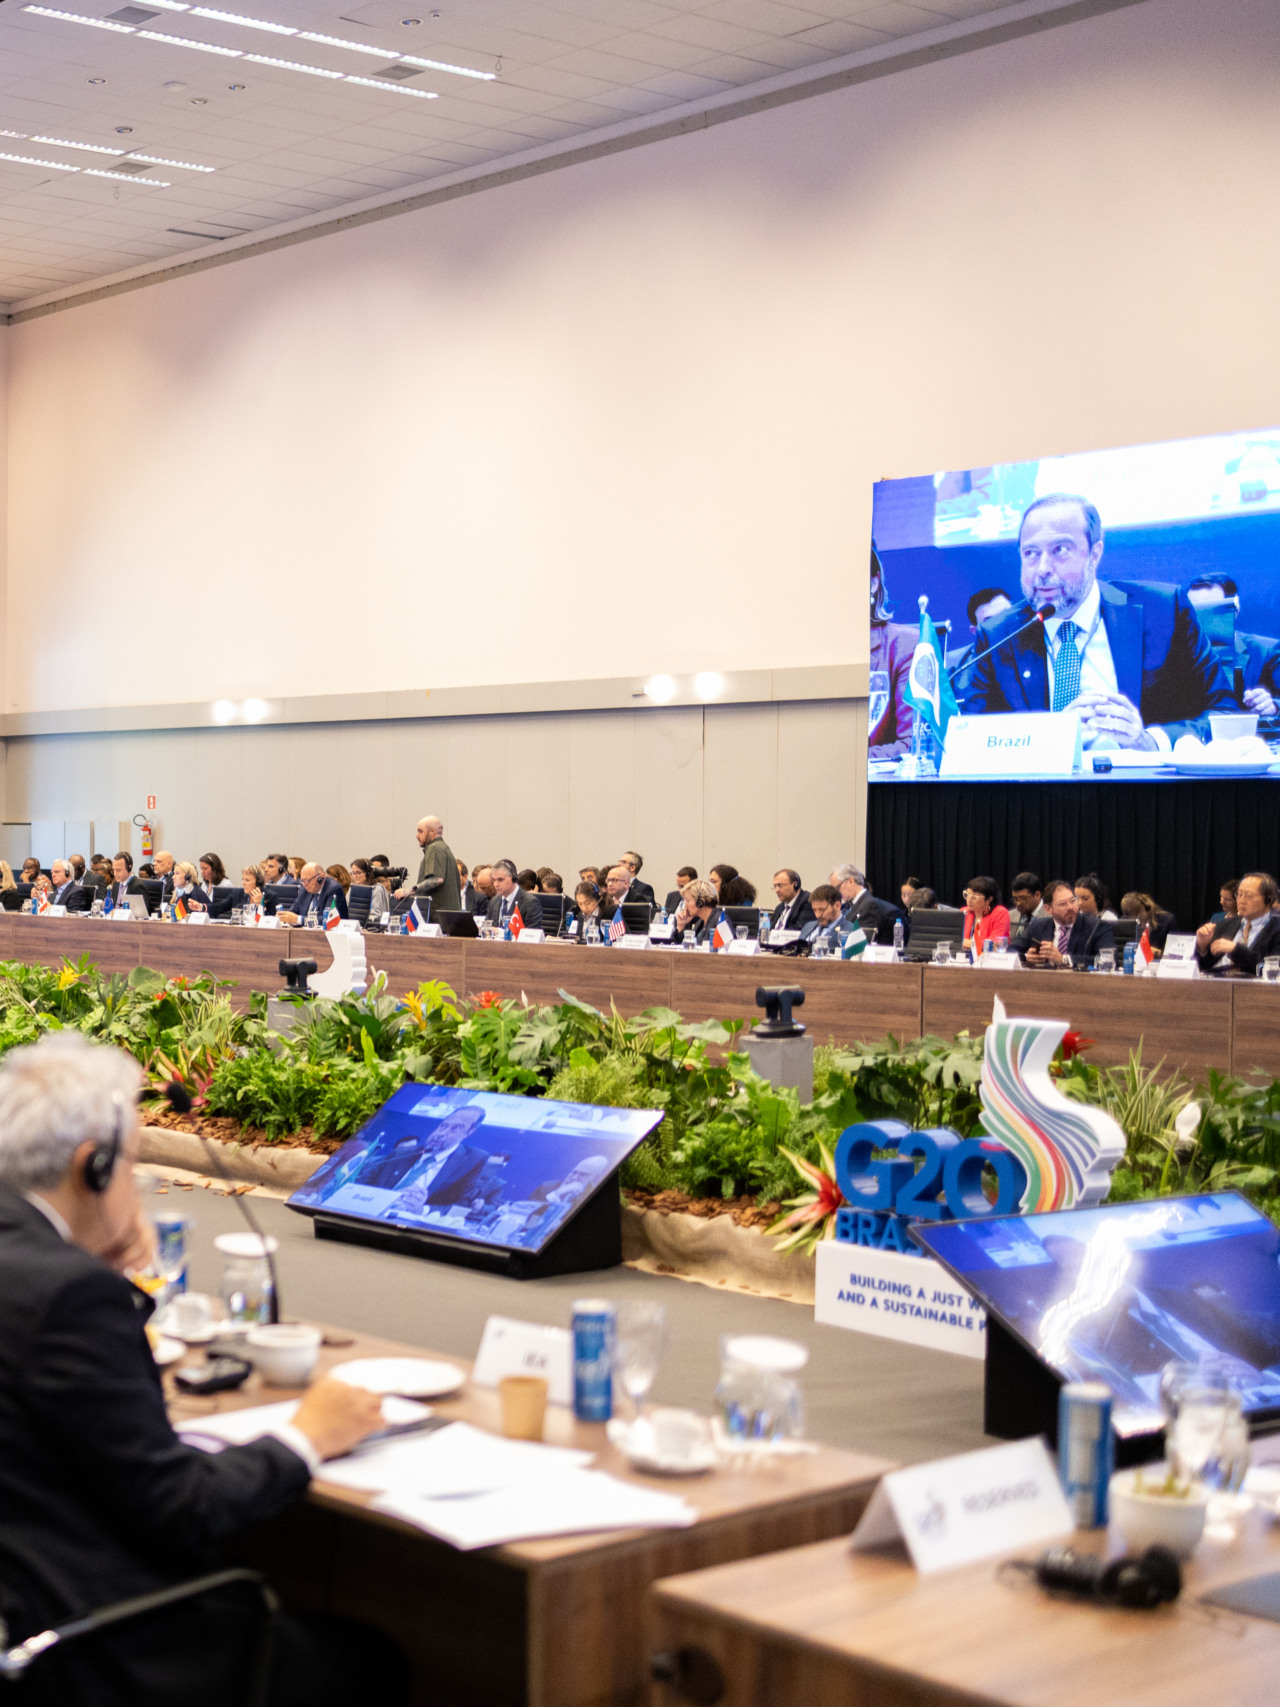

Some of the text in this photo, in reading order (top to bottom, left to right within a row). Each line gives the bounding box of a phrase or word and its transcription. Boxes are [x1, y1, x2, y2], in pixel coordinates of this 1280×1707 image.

[987, 735, 1031, 748] Brazil
[834, 1121, 1028, 1221] G20
[836, 1209, 924, 1259] BRA
[837, 1290, 865, 1306] AND
[870, 1296, 879, 1309] A
[883, 1298, 974, 1330] SUSTAINABLE
[850, 1273, 986, 1313] BUILDING A JUST W
